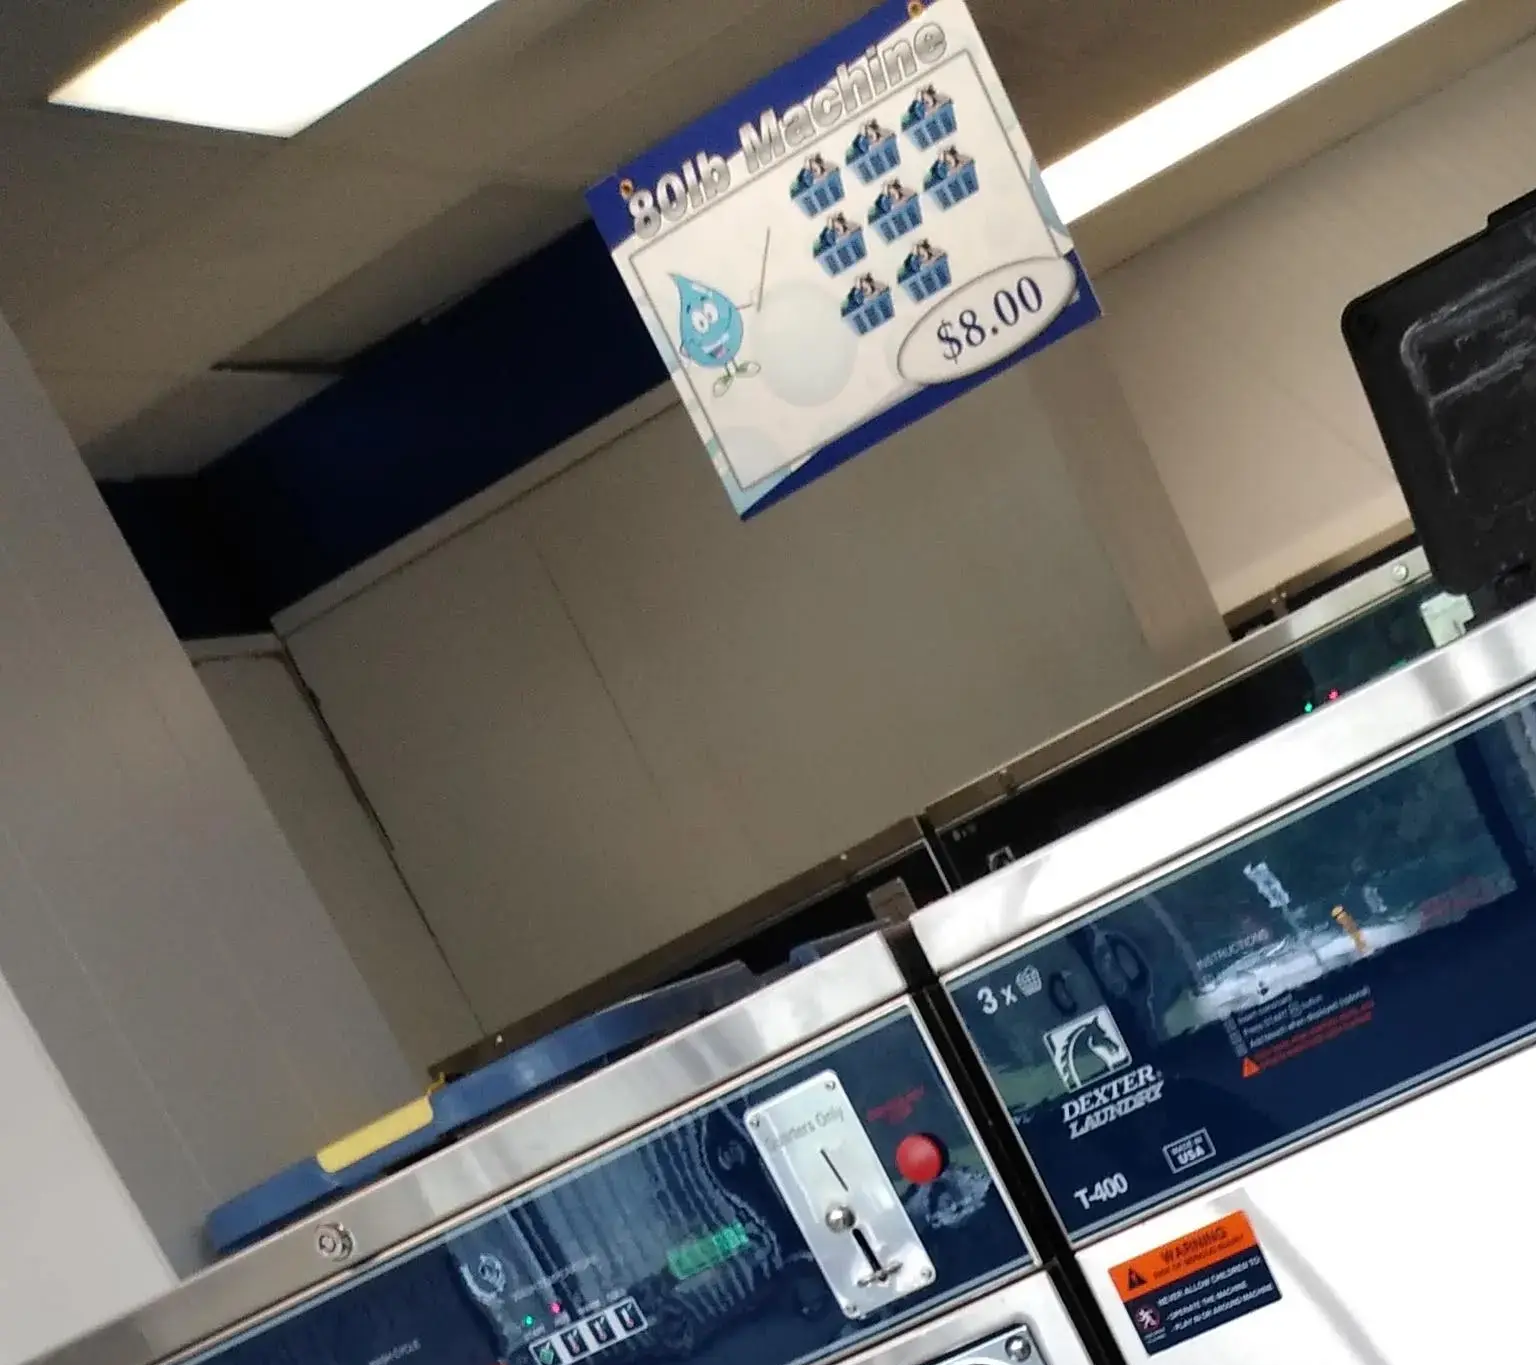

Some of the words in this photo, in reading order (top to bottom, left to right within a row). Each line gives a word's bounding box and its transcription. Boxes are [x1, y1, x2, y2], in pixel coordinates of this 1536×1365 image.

[628, 150, 731, 240] 80lb
[738, 21, 948, 174] Machine
[937, 275, 1043, 365] $8.00
[977, 986, 998, 1015] 3
[1062, 1063, 1156, 1123] DEXTER
[1069, 1080, 1163, 1141] LAUNDRY
[815, 1104, 844, 1128] Only
[1177, 1146, 1206, 1165] USA
[1073, 1172, 1128, 1211] T-400
[1160, 1226, 1228, 1265] WARNING
